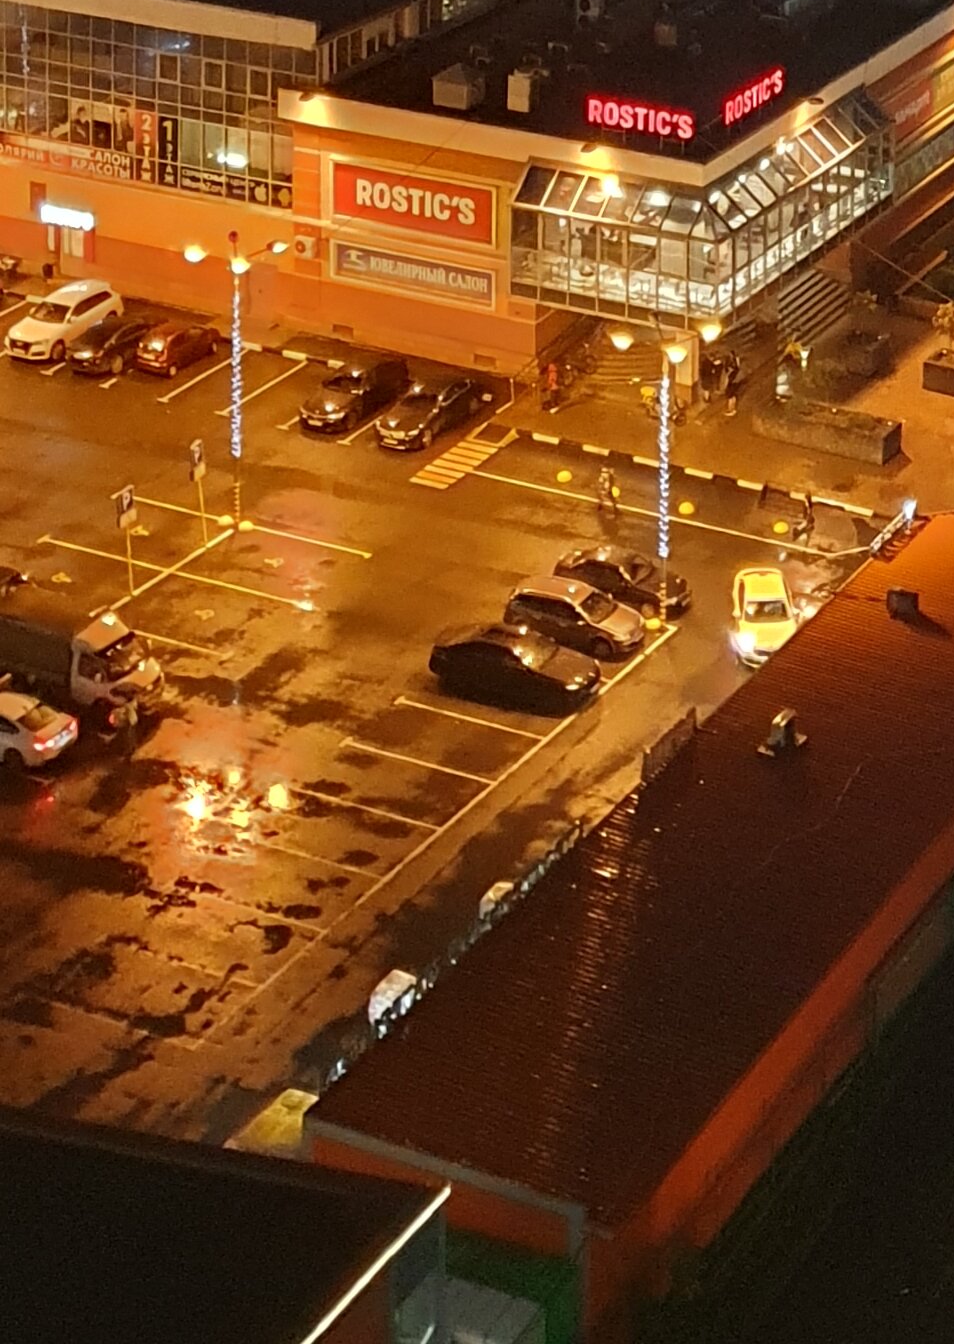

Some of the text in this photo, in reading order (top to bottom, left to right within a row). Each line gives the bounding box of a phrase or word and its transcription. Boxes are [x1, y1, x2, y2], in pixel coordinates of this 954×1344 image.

[725, 69, 784, 125] ROSTIC'S
[141, 114, 151, 131] 2
[162, 120, 173, 141] 1
[588, 98, 693, 139] ROSTIC'S
[71, 158, 130, 179] КРАСОТЫ
[88, 150, 130, 167] САЛОН
[356, 178, 476, 225] ROSTIC'S
[370, 256, 488, 293] ЮВЕЛИРНЫЙ САЛОН
